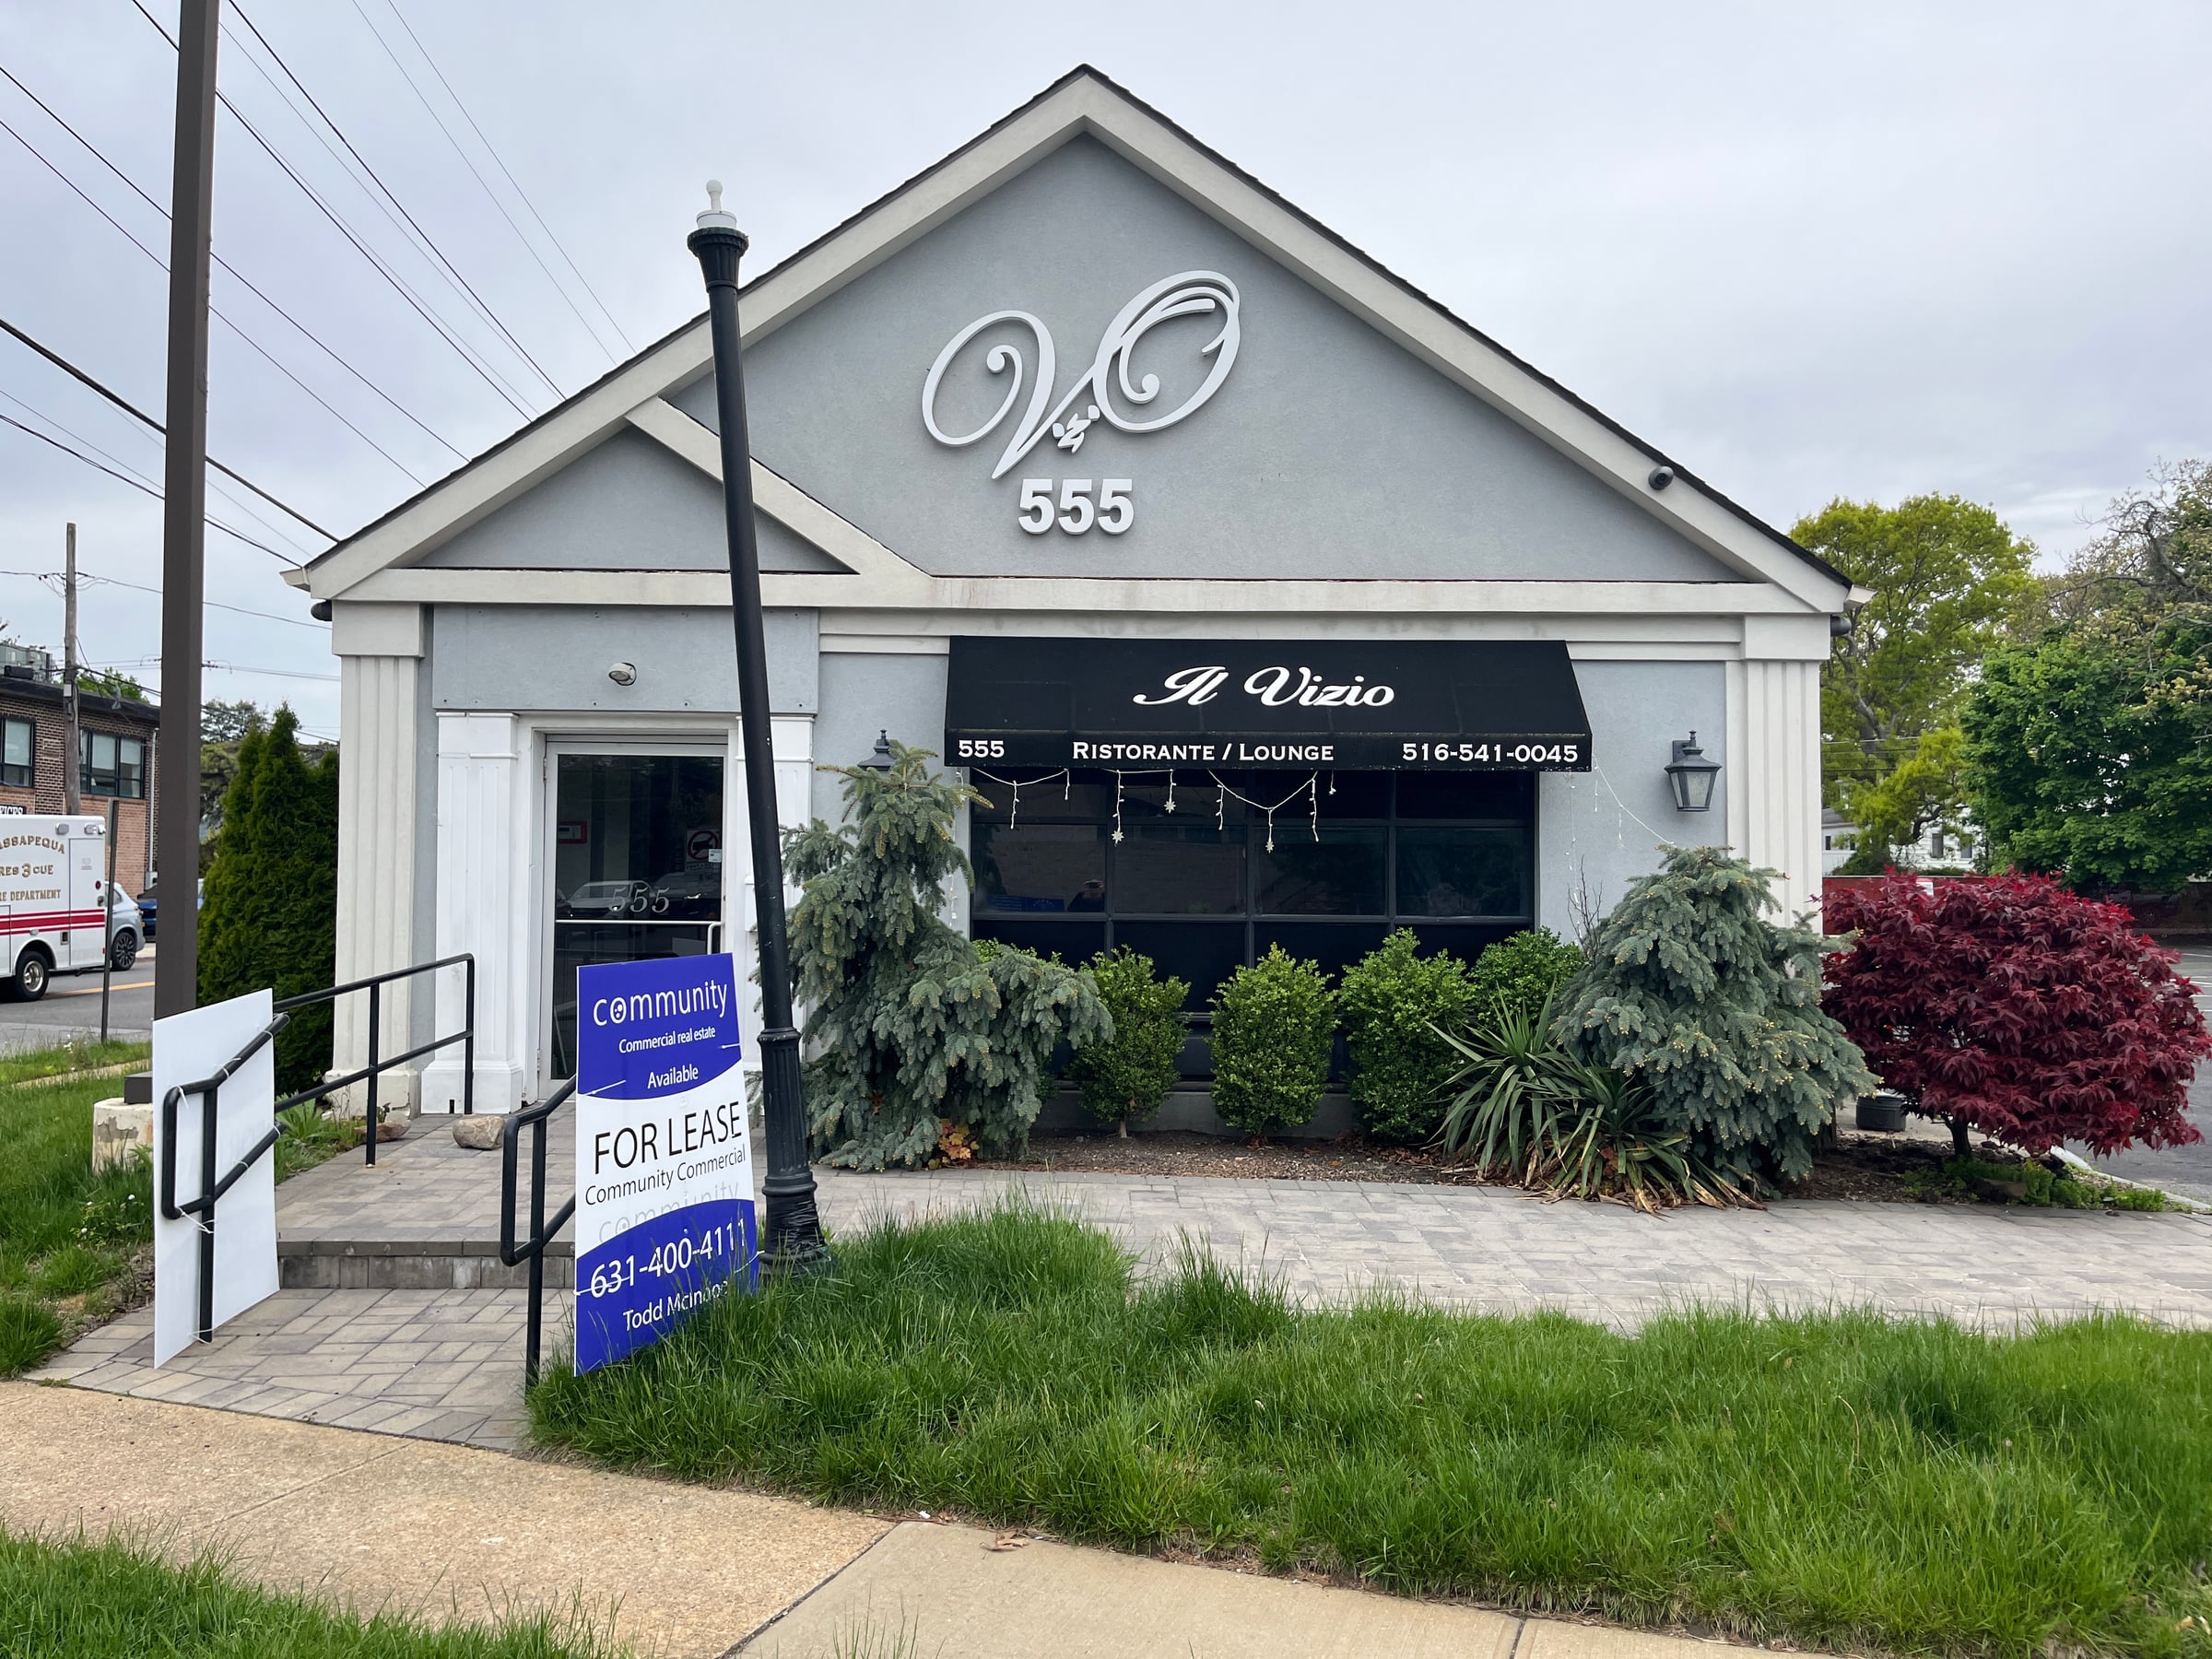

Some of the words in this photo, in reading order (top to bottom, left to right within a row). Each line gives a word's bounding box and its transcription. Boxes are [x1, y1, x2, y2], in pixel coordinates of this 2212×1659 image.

[1018, 477, 1135, 535] 555
[1243, 665, 1394, 707] Vizio
[958, 739, 1005, 759] 555
[1072, 741, 1215, 761] RISTORANTE
[1239, 742, 1335, 762] LOUNGE
[1402, 743, 1579, 762] 516-541-0045
[21, 863, 31, 877] 3
[33, 865, 54, 876] CUE
[10, 888, 62, 901] DEPARTMENT
[608, 887, 670, 913] 555
[618, 1030, 676, 1053] Commercial
[677, 1027, 693, 1043] real
[693, 1026, 716, 1041] estate
[647, 1063, 699, 1089] Available
[594, 1122, 659, 1175] FOR
[667, 1100, 743, 1157] LEASE
[585, 1168, 674, 1206] Community
[677, 1143, 747, 1181] Commercial
[590, 1218, 746, 1299] 631-400-4111
[623, 1298, 663, 1332] Todd
